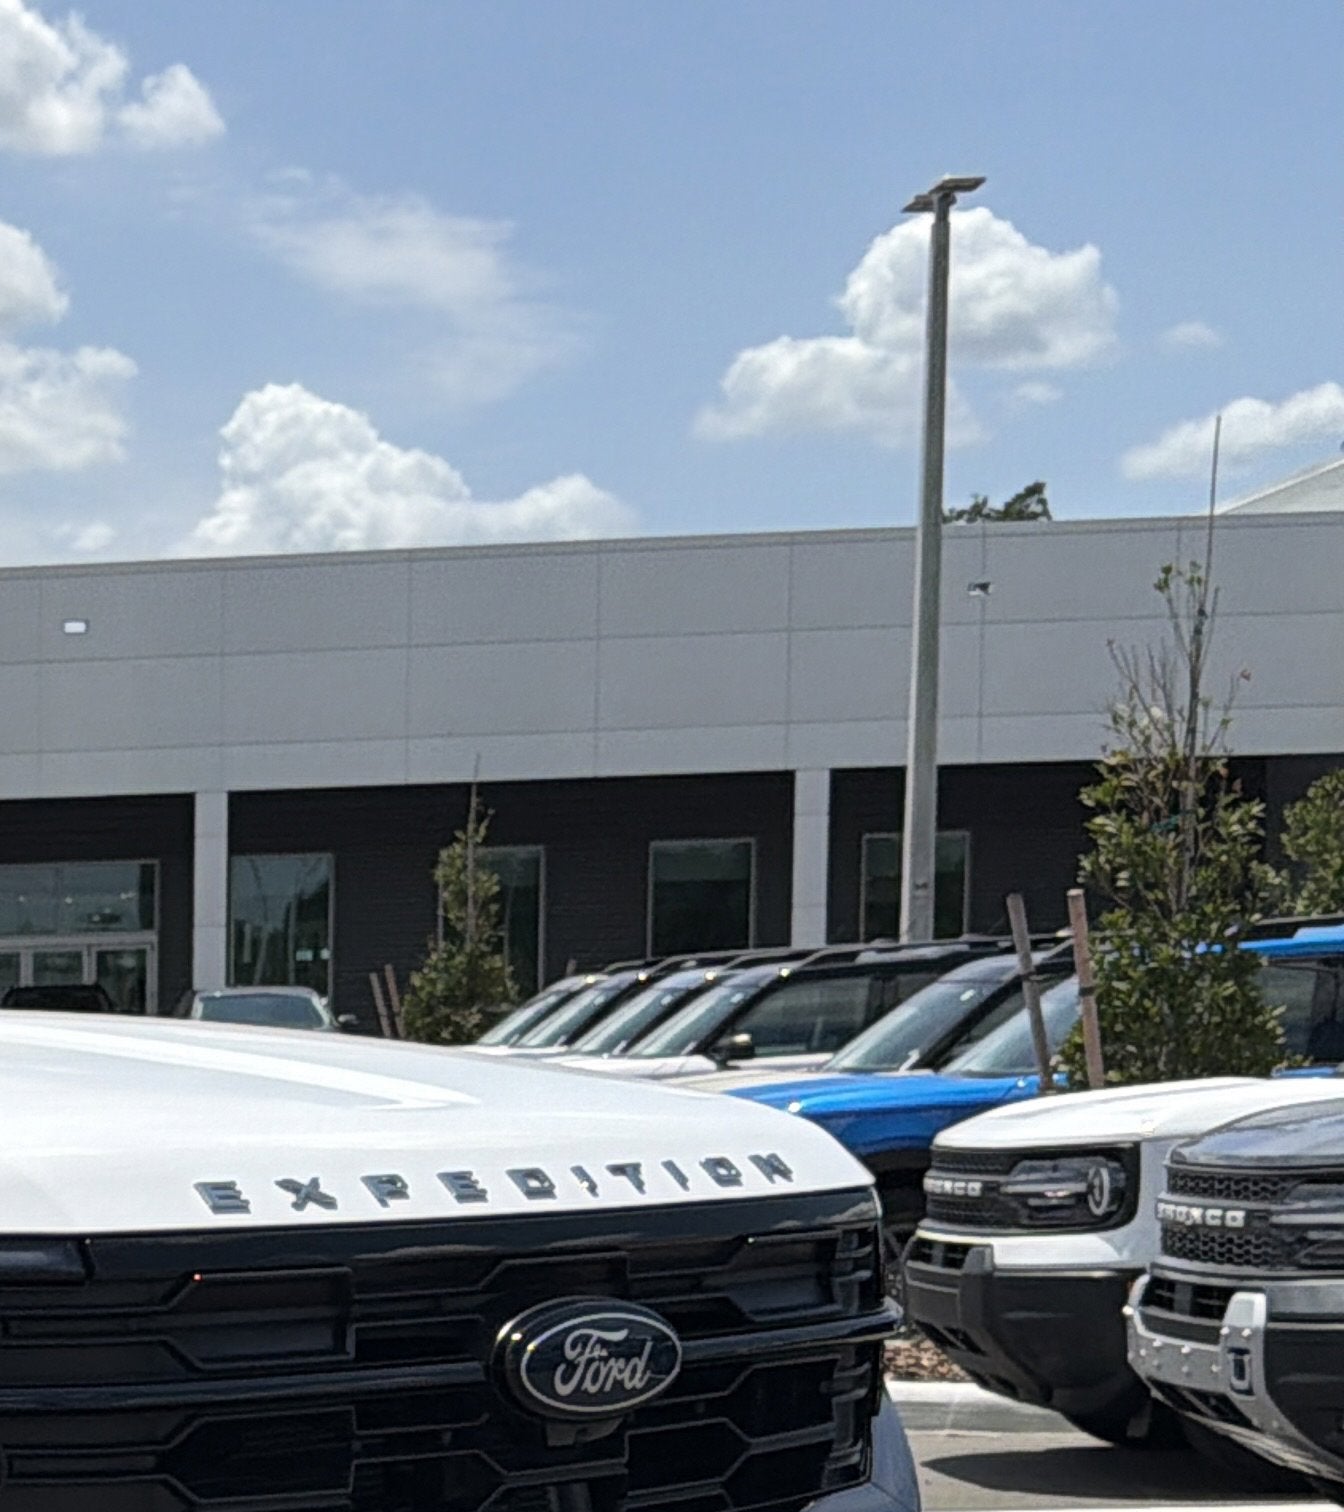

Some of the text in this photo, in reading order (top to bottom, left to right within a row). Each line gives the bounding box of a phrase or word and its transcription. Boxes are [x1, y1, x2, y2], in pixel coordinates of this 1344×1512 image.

[193, 1152, 794, 1215] EXPEDITION
[923, 1176, 983, 1197] NCO
[554, 1328, 653, 1397] Ford
